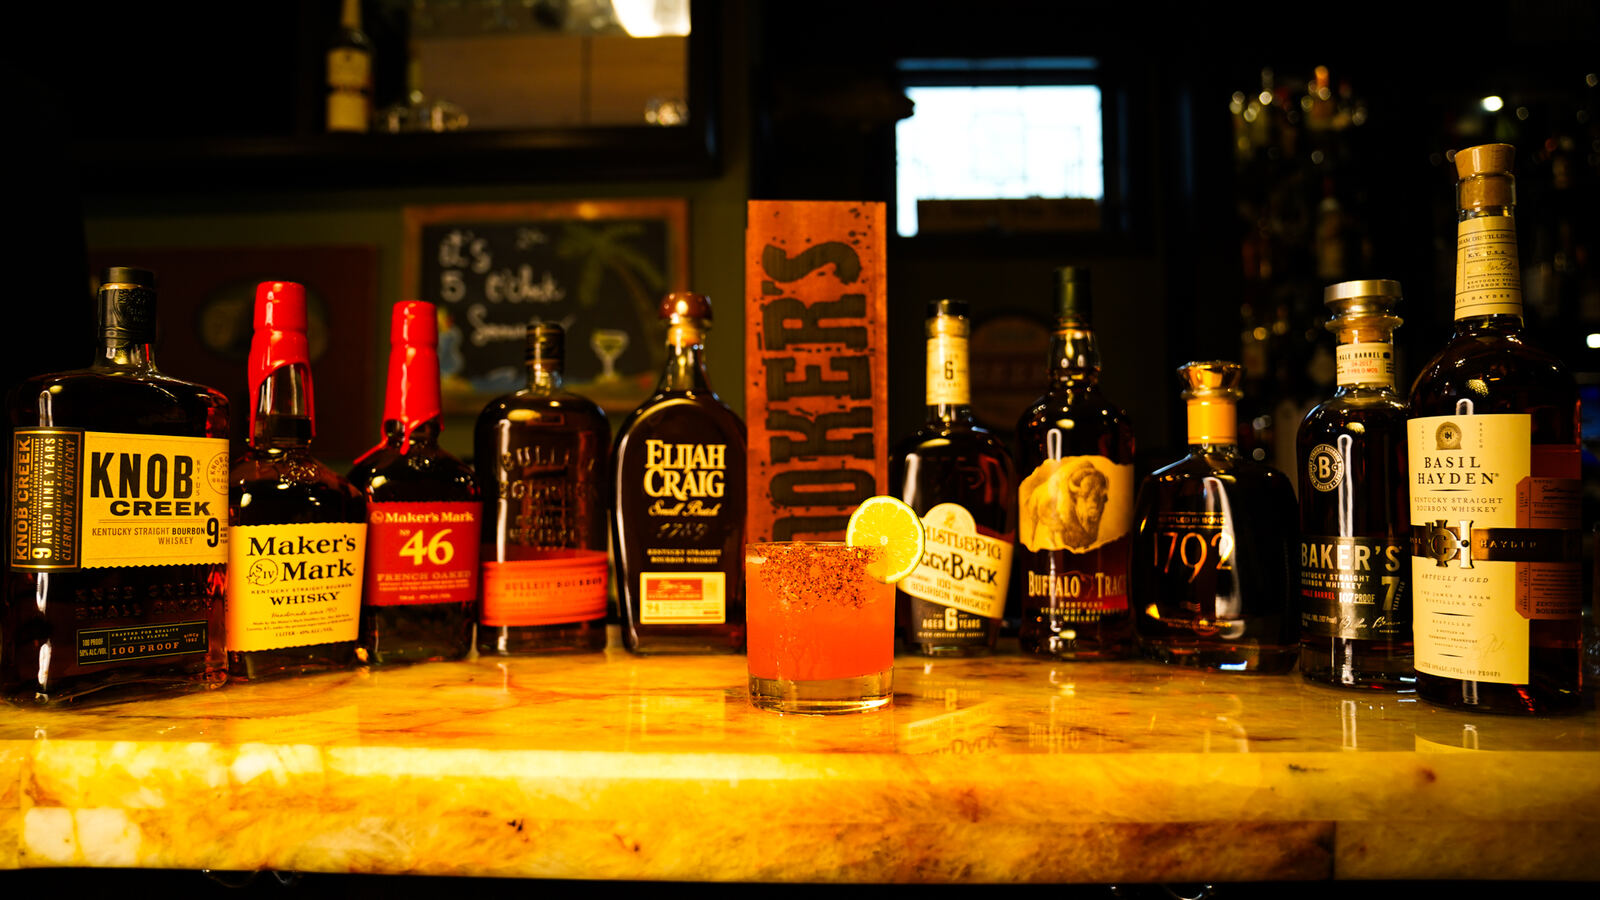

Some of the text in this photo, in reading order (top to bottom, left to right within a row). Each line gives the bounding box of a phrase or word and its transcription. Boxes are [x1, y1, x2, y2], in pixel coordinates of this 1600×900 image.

[944, 361, 953, 380] 6
[645, 439, 727, 473] ELIJAH
[1318, 456, 1331, 478] B
[1424, 456, 1481, 469] BASIL
[64, 439, 76, 496] KENTUCKY
[90, 451, 193, 499] KNOB
[1418, 472, 1494, 485] HAYDEN
[42, 437, 55, 544] AGED NINE YEARS
[643, 468, 725, 501] CRAIG
[110, 500, 211, 516] CREEK
[1451, 497, 1504, 505] STRAIGHT
[385, 511, 474, 523] Maker's Mark
[16, 507, 29, 560] KNOB
[92, 527, 206, 536] KENTUCKY STRAIGHT BOURBON
[158, 537, 194, 545] WHISKEY
[206, 517, 219, 548] 9
[925, 525, 1001, 560] ISTLEPIG
[32, 547, 52, 559] 9
[246, 534, 356, 556] Maker's
[399, 529, 454, 566] 46
[1154, 532, 1234, 583] 1792
[1301, 542, 1400, 573] BAKER'S
[280, 559, 354, 581] Mark
[1329, 573, 1370, 582] STRAIGHT
[1028, 570, 1126, 598] BUFFALO TRAC
[1326, 581, 1362, 589] WHISKEY
[1381, 576, 1400, 611] 7
[269, 591, 340, 606] WHISKY
[1354, 593, 1376, 603] PROOF
[922, 619, 944, 629] AGED
[945, 607, 958, 631] 6
[959, 619, 980, 629] YEARS
[112, 642, 180, 655] 100 PROOF
